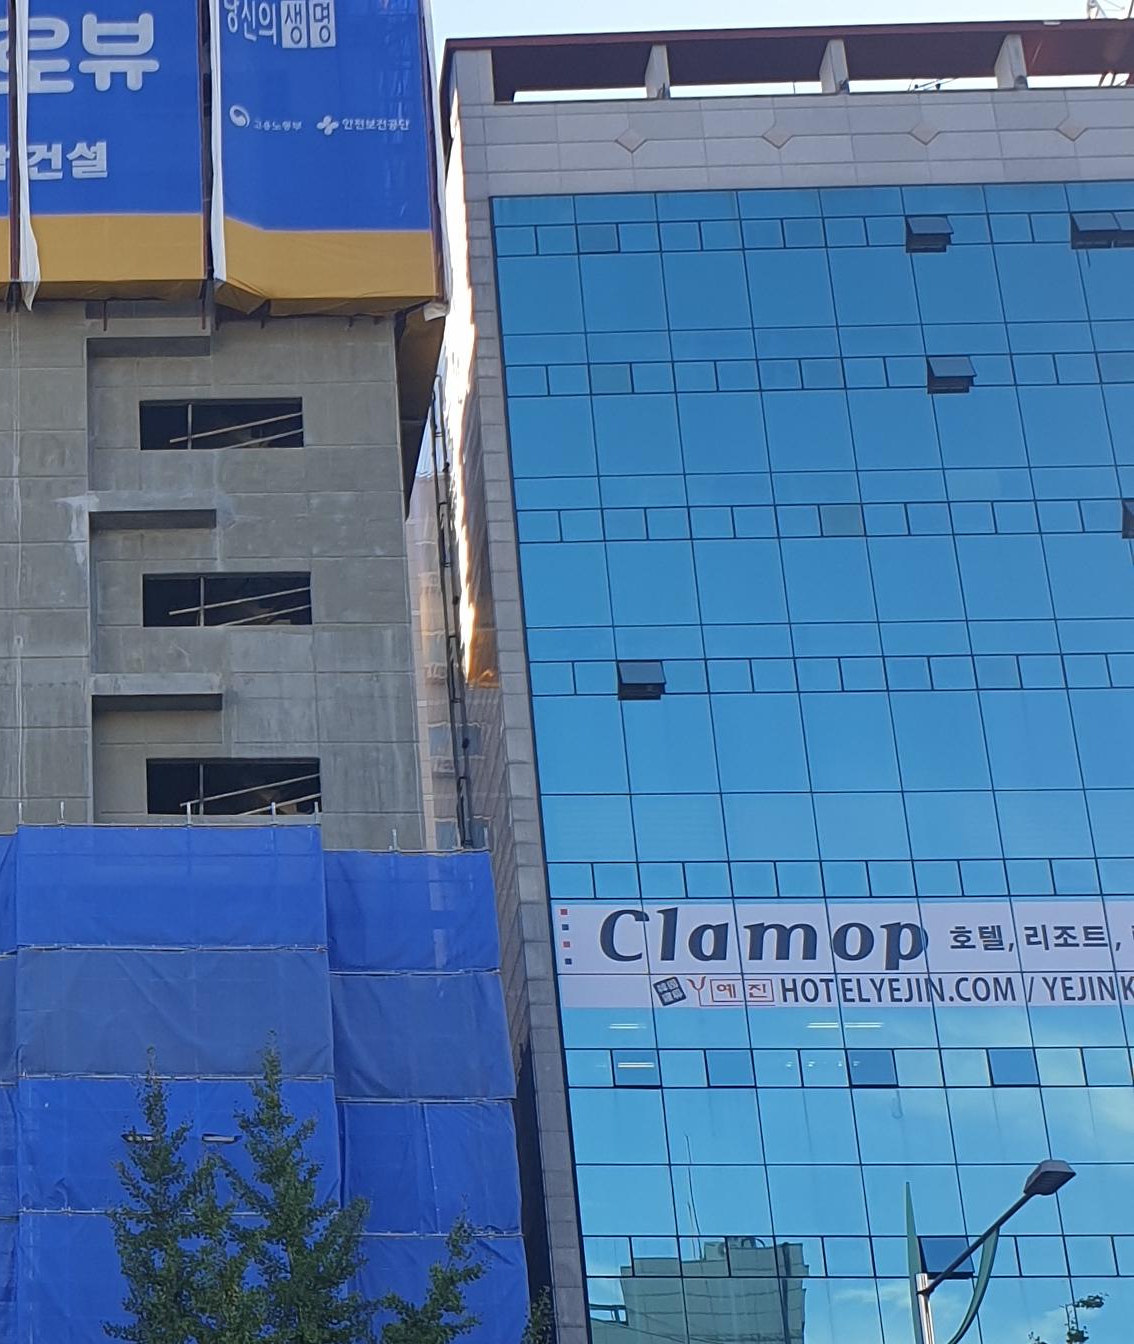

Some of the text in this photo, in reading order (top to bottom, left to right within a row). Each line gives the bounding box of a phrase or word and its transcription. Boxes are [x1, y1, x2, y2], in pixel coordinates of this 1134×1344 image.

[284, 1, 332, 45] 생명
[341, 117, 411, 132] 안전보건공단
[599, 906, 929, 971] Clamop
[781, 976, 1016, 1003] HOTELYEJIN.COM
